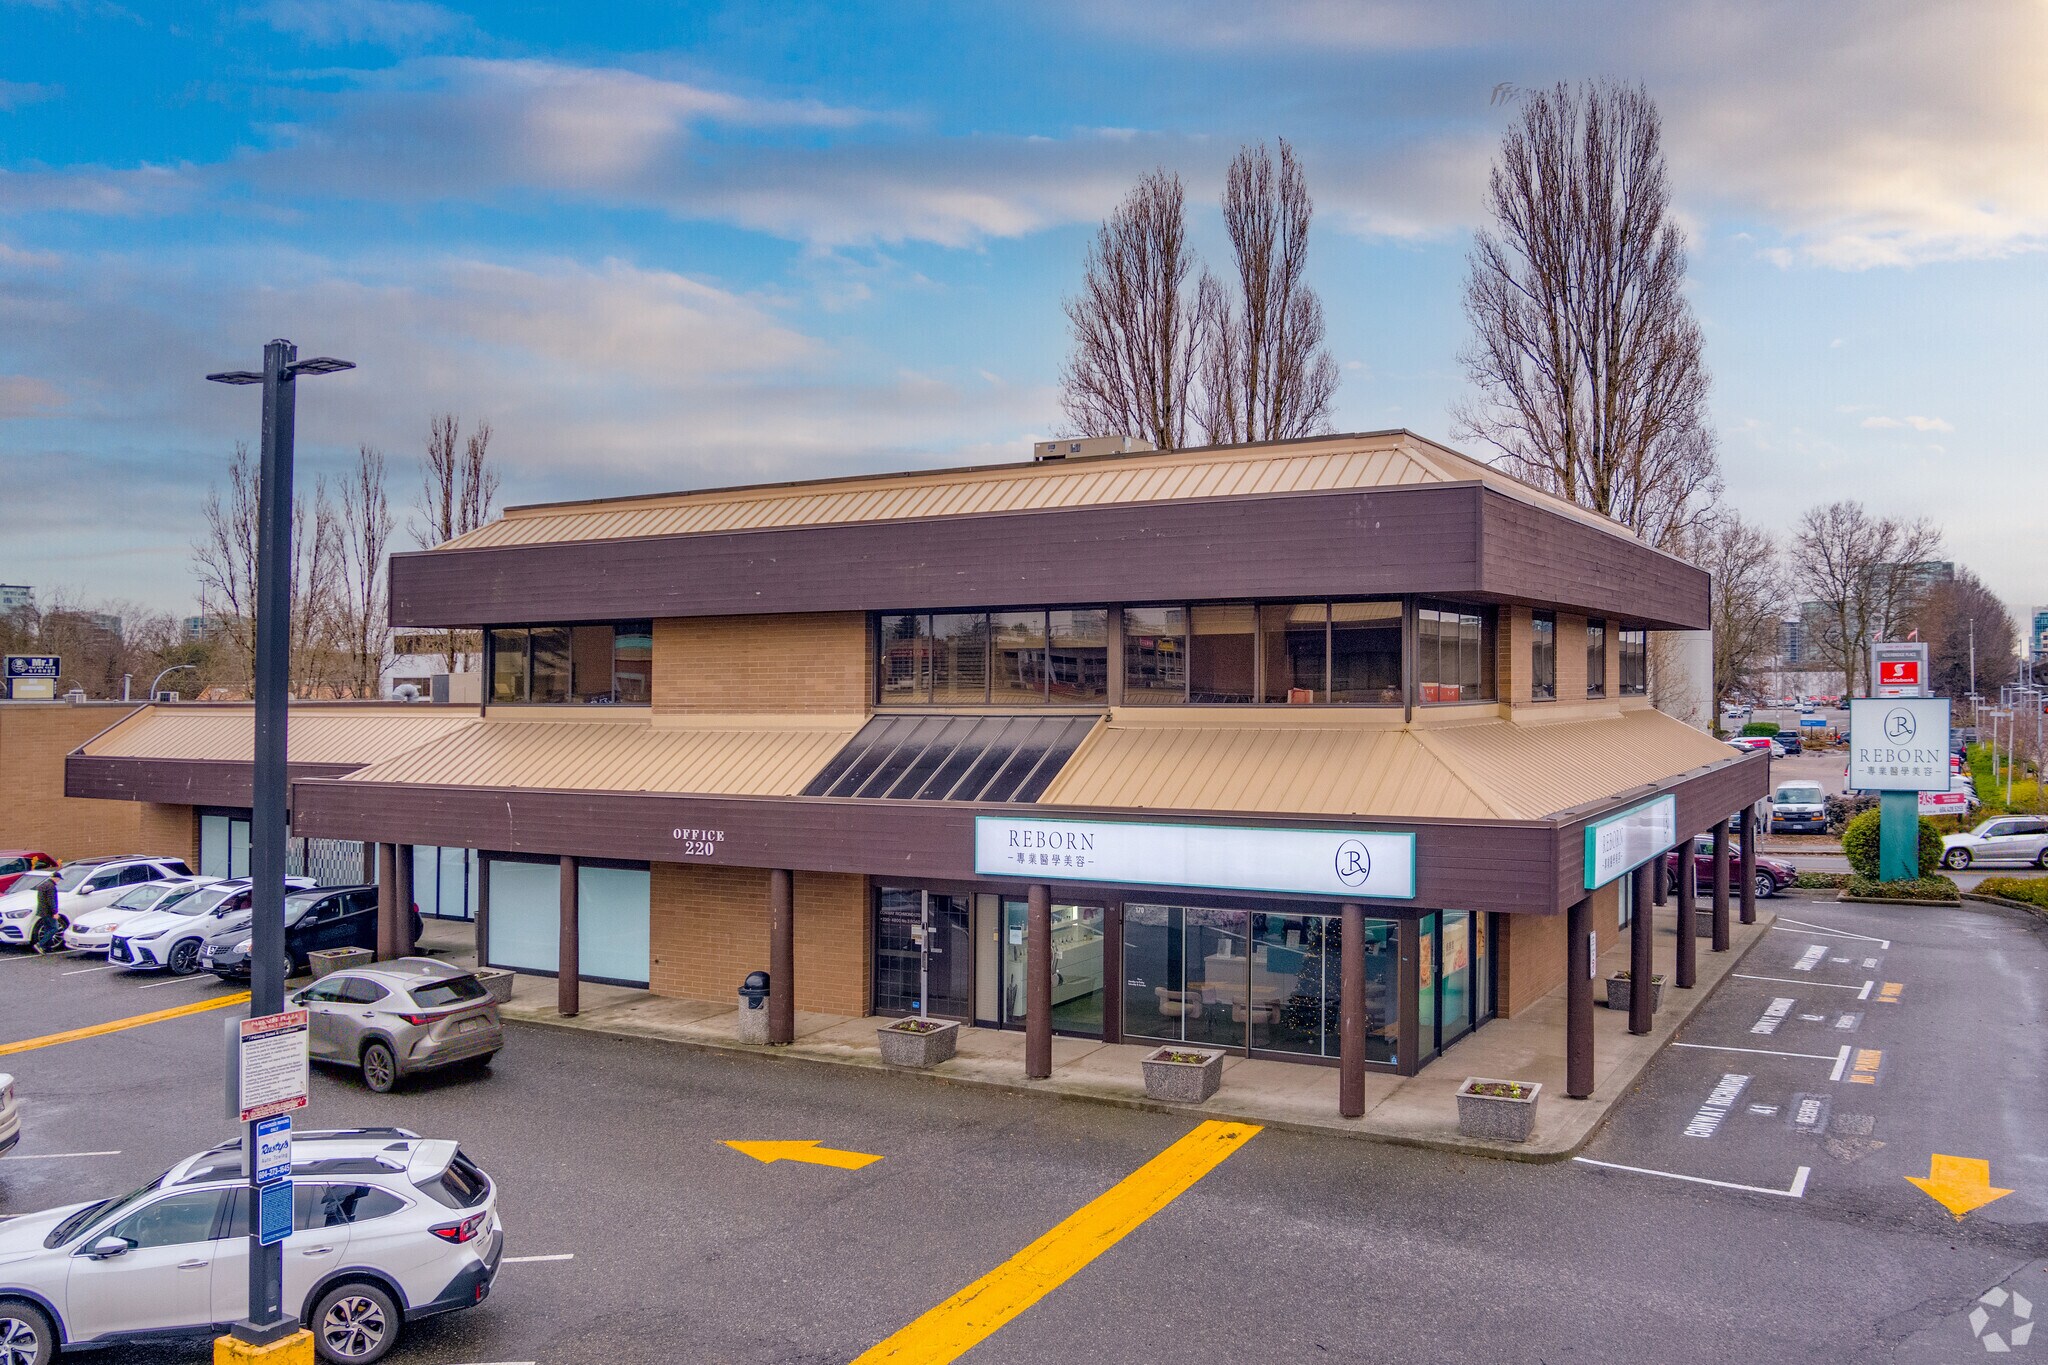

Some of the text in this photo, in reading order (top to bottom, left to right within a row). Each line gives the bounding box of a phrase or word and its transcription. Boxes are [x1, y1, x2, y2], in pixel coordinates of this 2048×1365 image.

[1860, 748, 1940, 763] REBORN
[673, 828, 725, 842] OFFICE
[1009, 829, 1095, 850] REBORN
[685, 841, 714, 856] 220
[1684, 1074, 1749, 1137] CONWAY RICHMOND
[1750, 1104, 1778, 1115] 41
[1795, 1099, 1820, 1124] RESERVED
[261, 1140, 289, 1155] Rusty's
[258, 1164, 290, 1180] 604-273-1645
